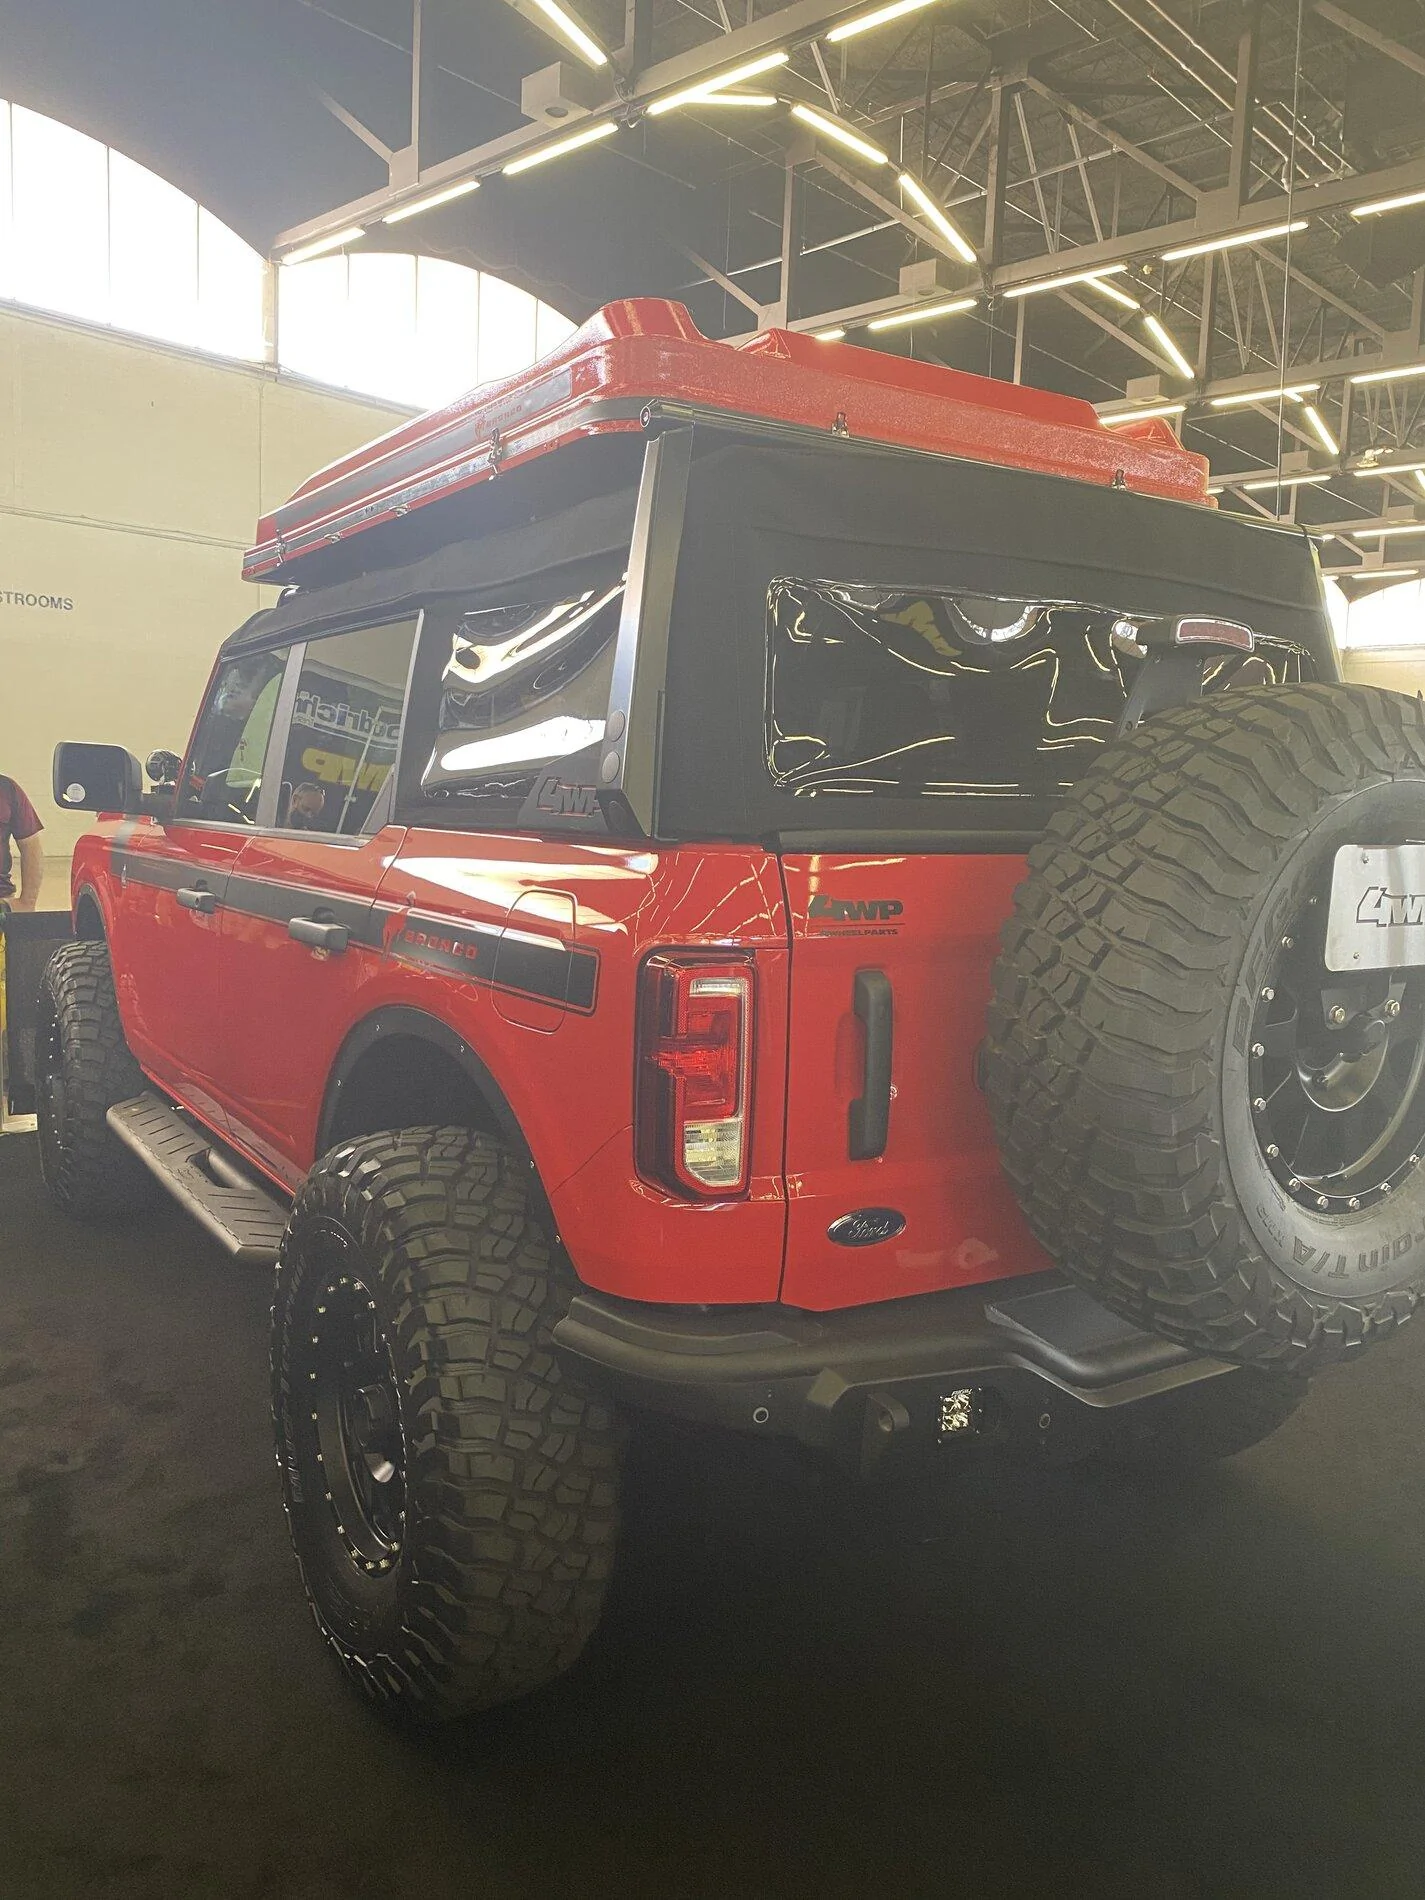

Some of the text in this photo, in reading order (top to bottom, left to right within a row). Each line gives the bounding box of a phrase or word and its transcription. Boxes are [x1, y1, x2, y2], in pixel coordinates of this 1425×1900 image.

[0, 590, 74, 611] TROOMS
[808, 893, 904, 922] 4WP
[1355, 886, 1425, 928] 4W
[404, 929, 479, 960] BRONCO
[847, 1220, 889, 1239] Ford
